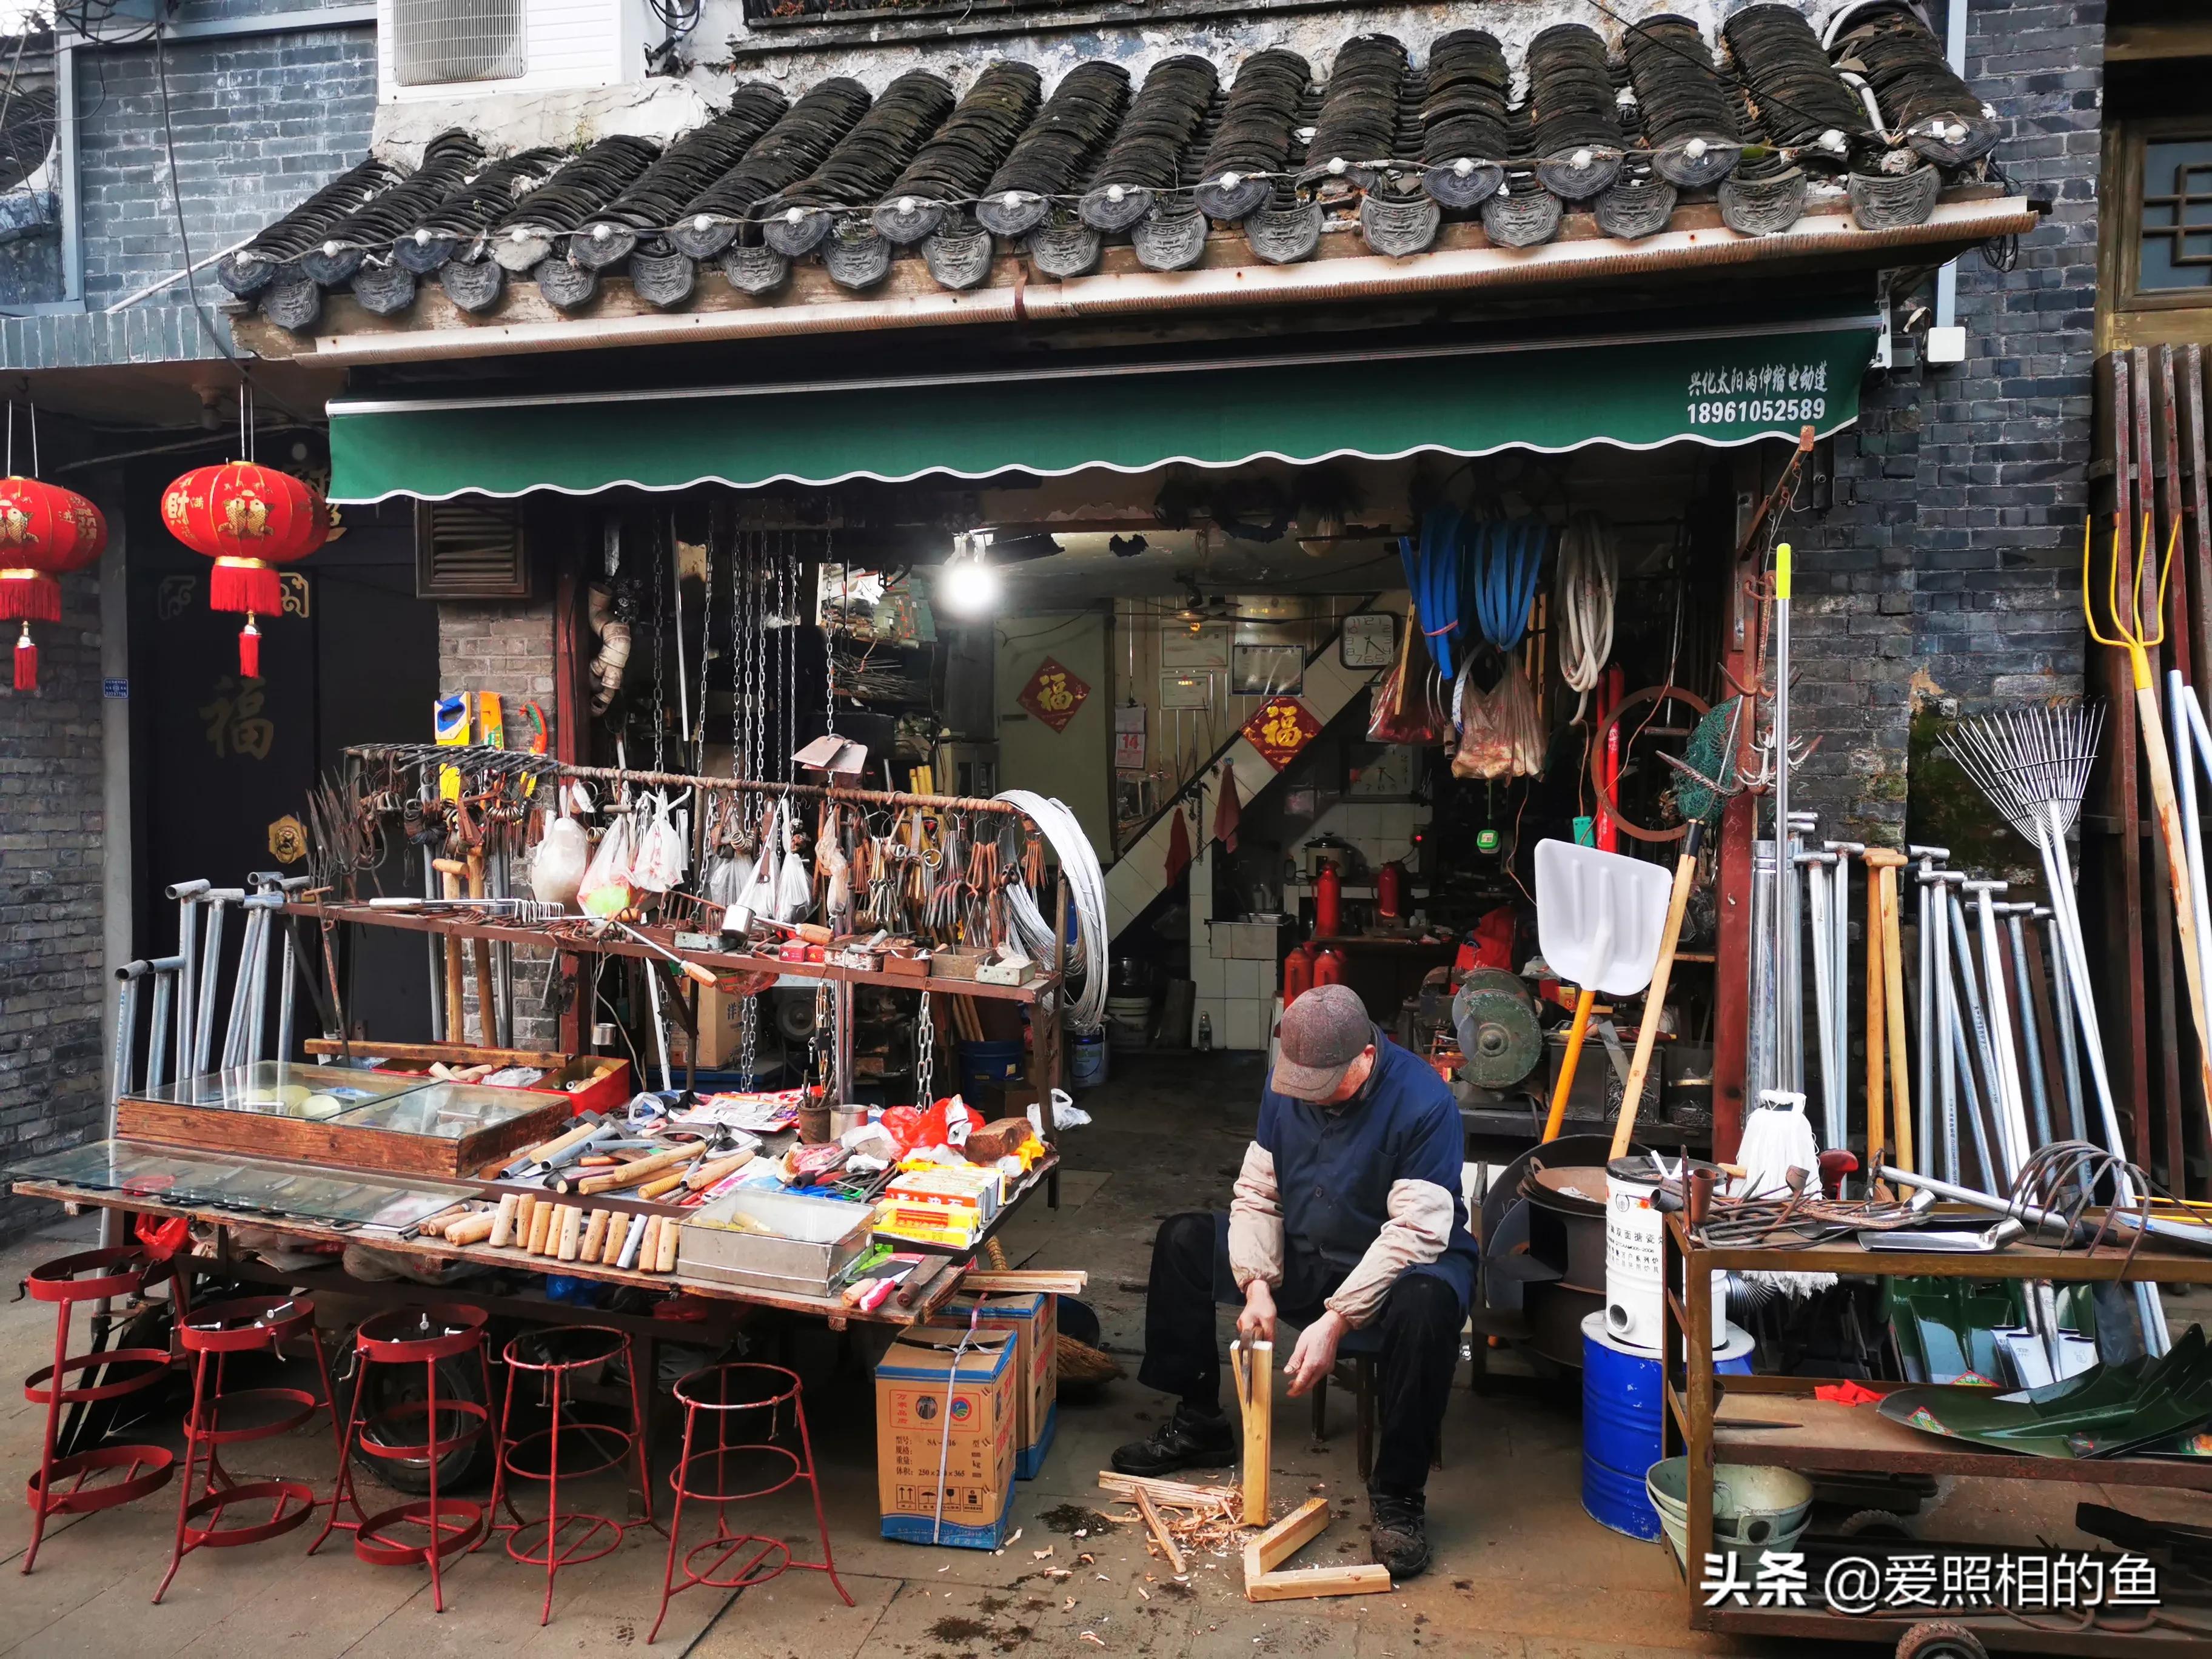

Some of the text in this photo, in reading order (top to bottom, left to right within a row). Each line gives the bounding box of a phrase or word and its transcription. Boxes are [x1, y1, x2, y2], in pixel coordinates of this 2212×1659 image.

[1687, 398, 1826, 424] 18961052589
[1037, 672, 1073, 711] 福
[198, 674, 273, 760] 福
[1261, 706, 1302, 746] 福
[1122, 733, 1139, 749] 14
[973, 1461, 980, 1469] kg
